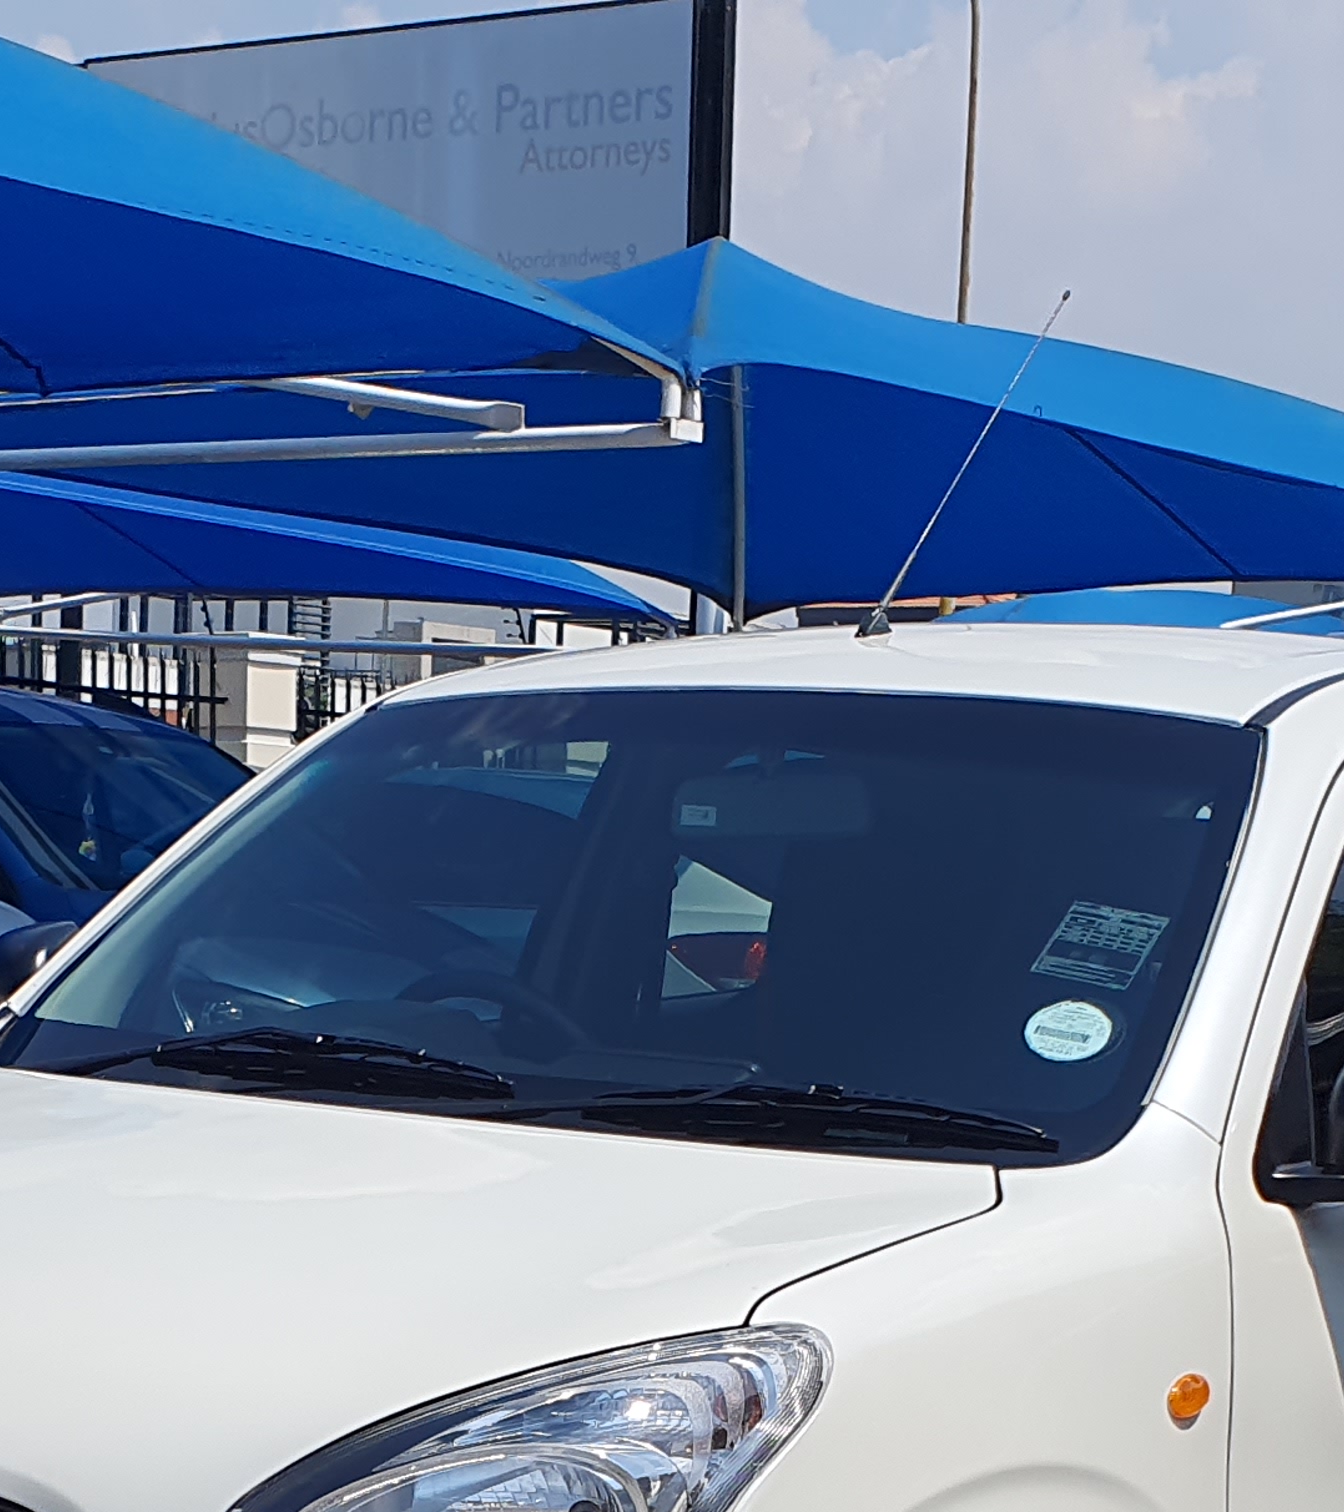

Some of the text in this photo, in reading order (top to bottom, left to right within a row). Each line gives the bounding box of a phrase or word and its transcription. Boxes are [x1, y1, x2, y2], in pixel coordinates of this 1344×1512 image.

[449, 88, 478, 136] &
[495, 83, 674, 134] Partners
[519, 137, 671, 176] Attorneys
